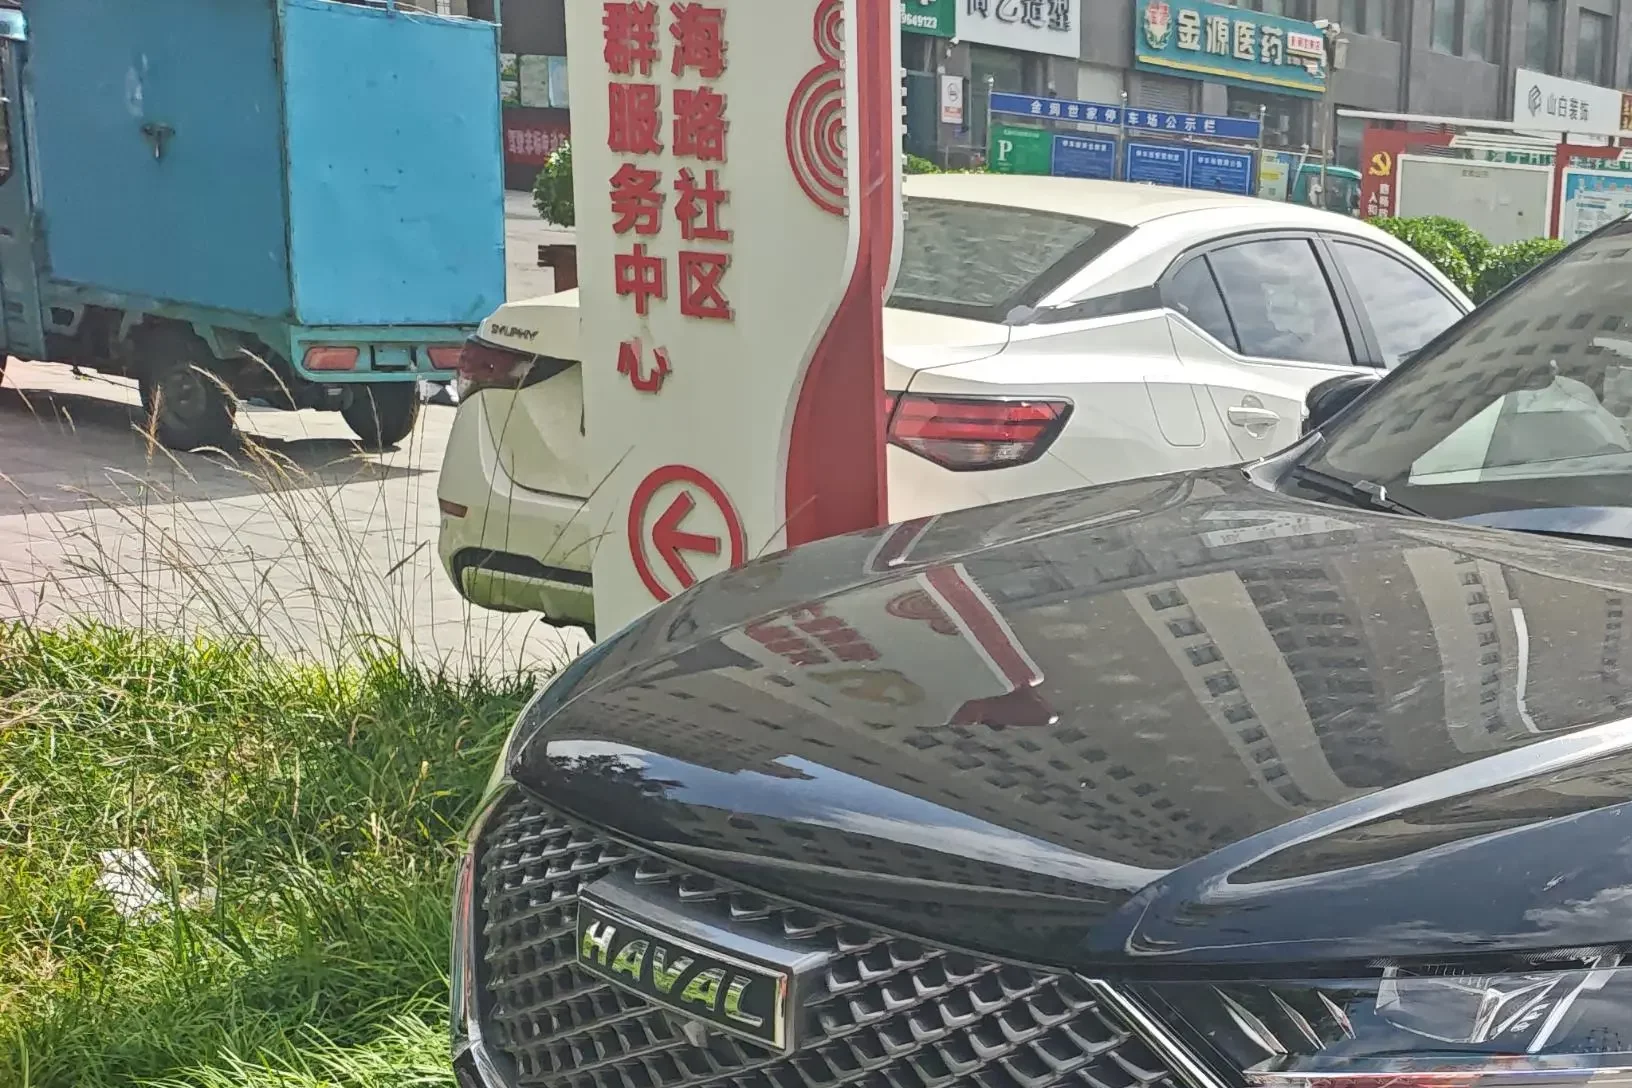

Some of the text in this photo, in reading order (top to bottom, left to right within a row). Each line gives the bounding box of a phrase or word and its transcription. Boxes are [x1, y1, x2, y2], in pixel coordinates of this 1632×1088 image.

[1177, 8, 1284, 66] 金源医药
[668, 0, 735, 323] 海路社区
[998, 139, 1013, 161] P
[602, 0, 672, 395] 群服务中心
[491, 323, 540, 341] SYLPHY
[582, 919, 764, 1029] HAVAL
